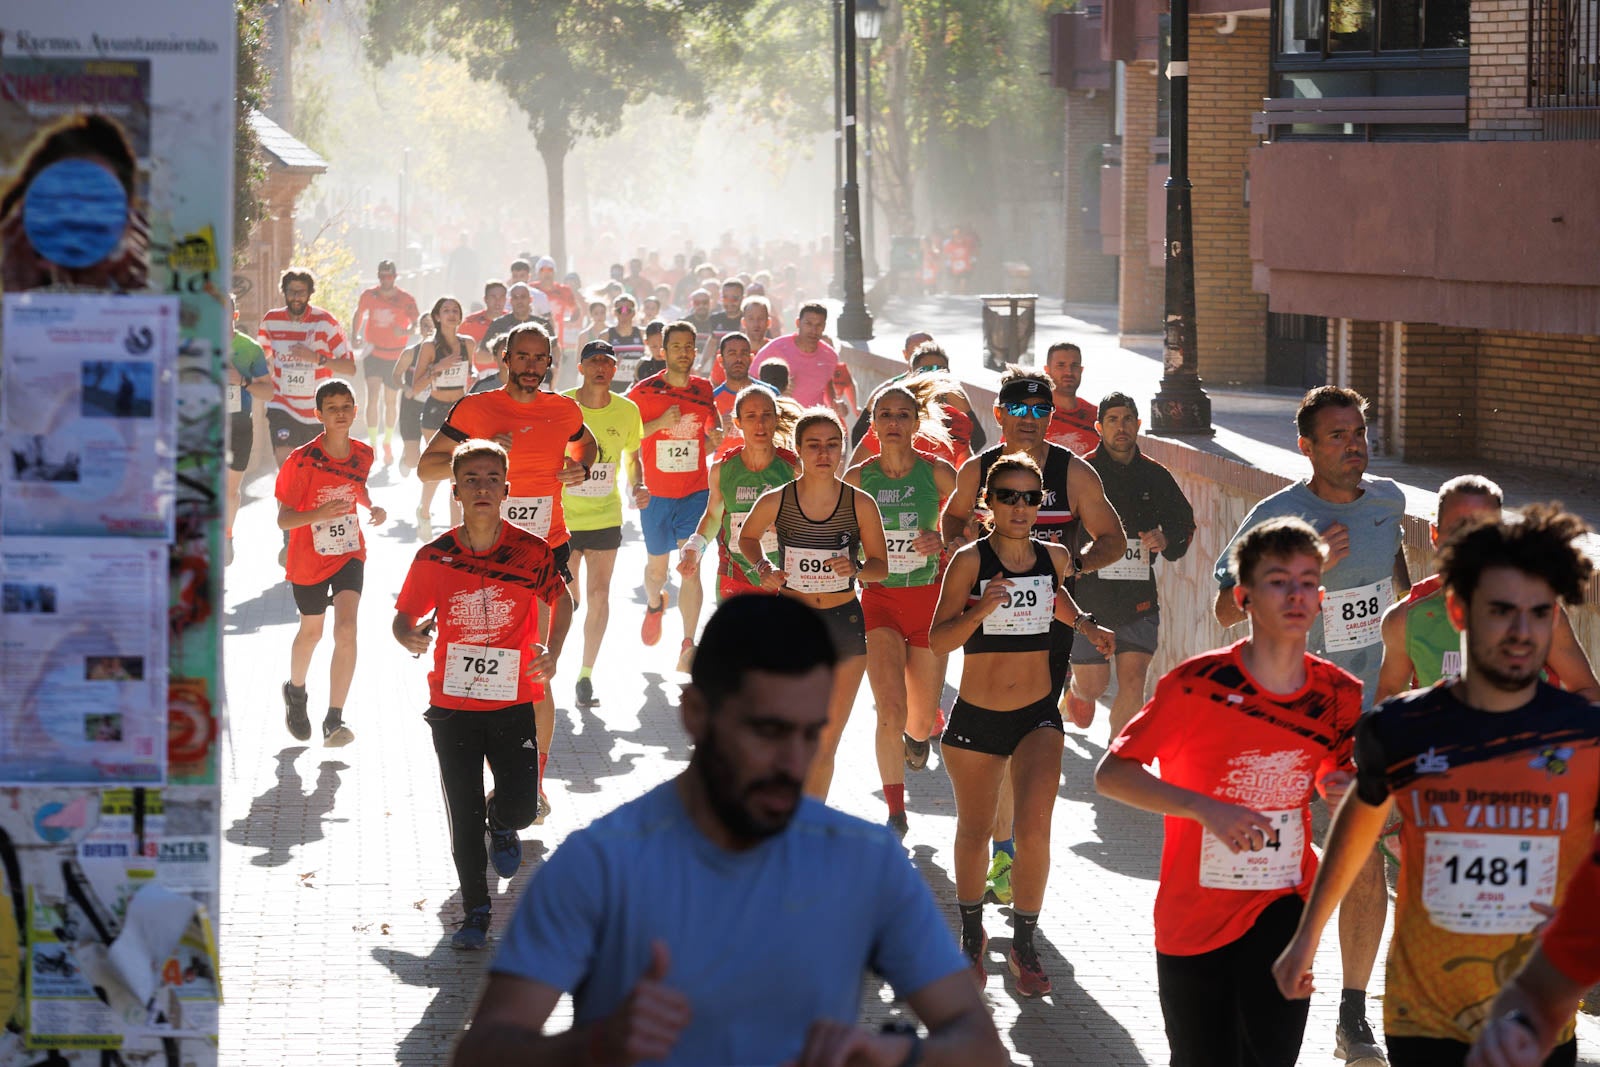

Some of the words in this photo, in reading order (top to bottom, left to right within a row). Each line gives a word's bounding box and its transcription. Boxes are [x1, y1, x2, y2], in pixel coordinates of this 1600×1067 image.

[287, 375, 305, 384] 340
[667, 447, 689, 457] 124
[589, 470, 607, 481] 09
[735, 486, 759, 500] ATARFE
[876, 489, 901, 503] ATARFE
[507, 506, 539, 520] 627
[329, 524, 346, 538] 55
[799, 558, 832, 573] 698
[1341, 596, 1380, 621] 838
[1345, 620, 1367, 630] CARLOS
[463, 656, 499, 675] 762
[1441, 651, 1462, 675] ATA
[1228, 769, 1310, 790] carrera
[1424, 788, 1461, 803] Club
[1466, 788, 1553, 806] Deportivo
[1411, 790, 1449, 827] LA
[1464, 792, 1569, 831] ZUBIA
[1247, 857, 1269, 865] HUGO
[1444, 855, 1529, 886] 1481
